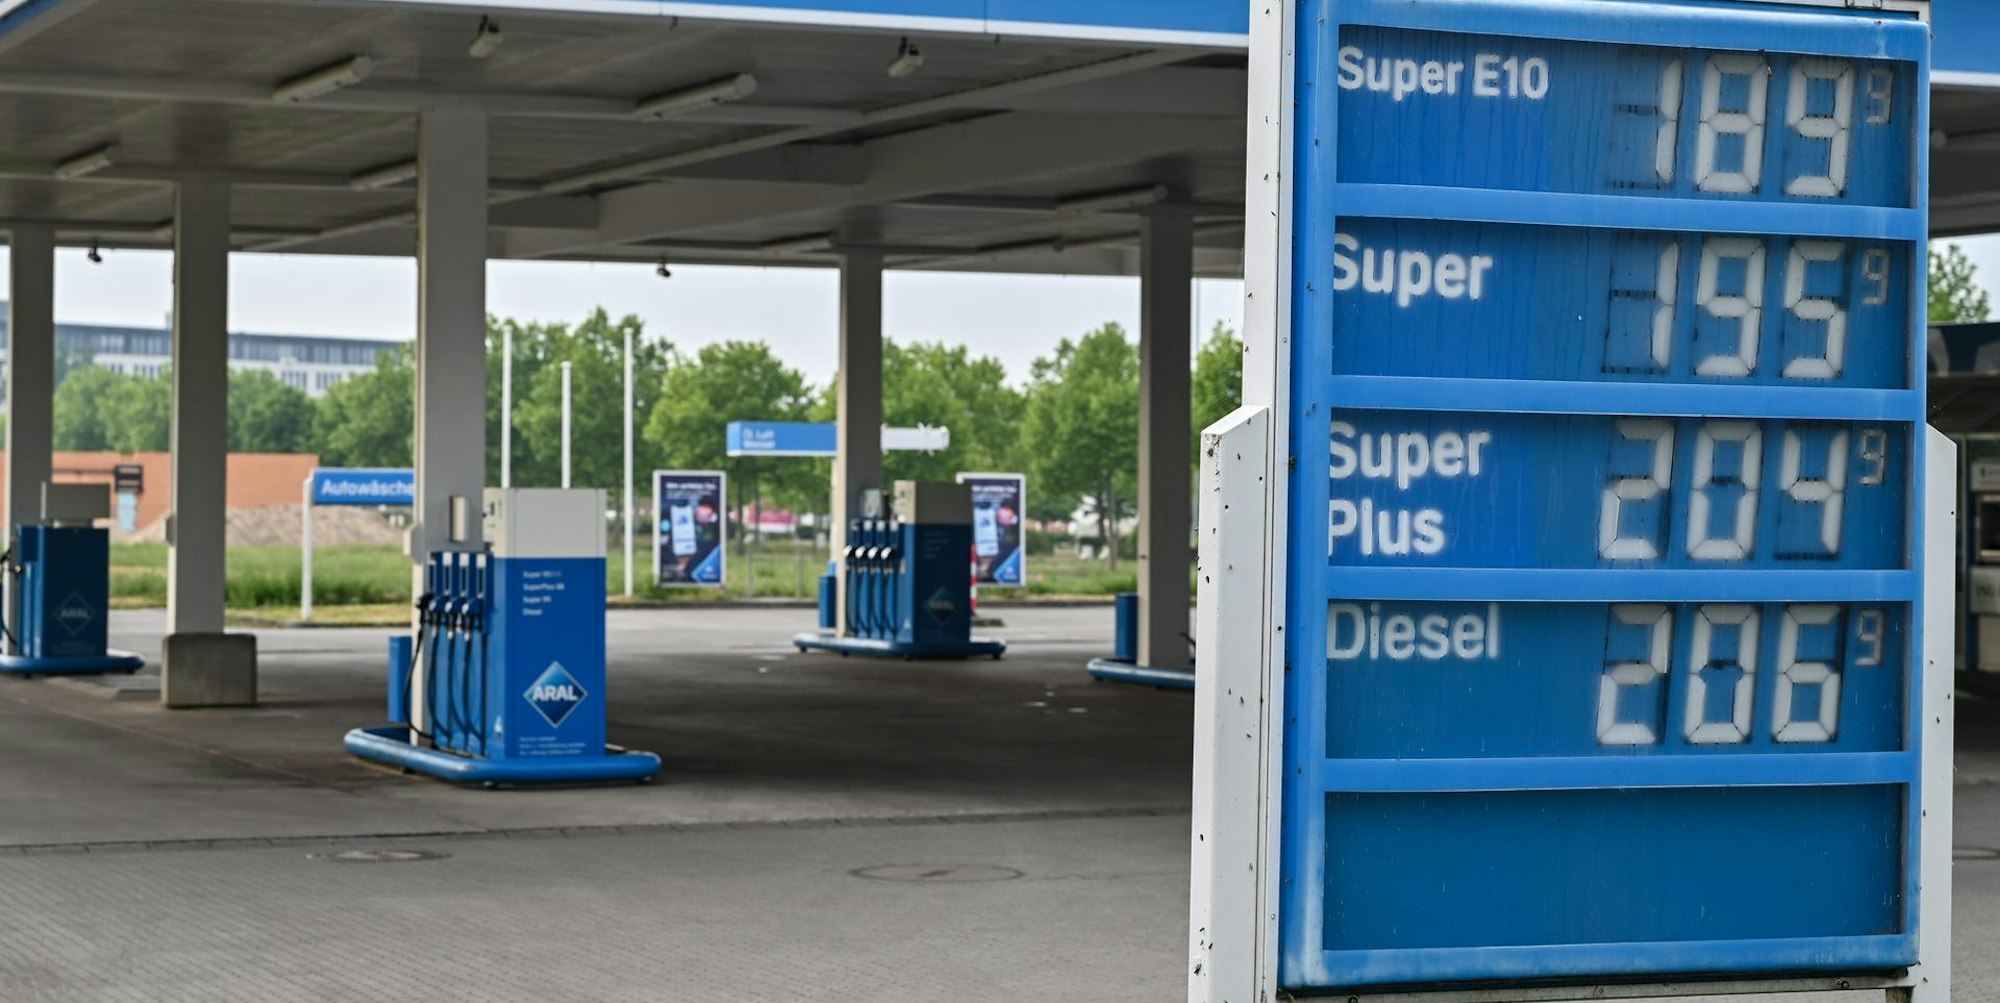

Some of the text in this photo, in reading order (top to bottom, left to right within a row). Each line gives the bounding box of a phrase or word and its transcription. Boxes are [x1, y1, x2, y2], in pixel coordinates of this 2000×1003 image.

[1337, 46, 1550, 101] Super E10
[1655, 52, 1853, 197] 189
[1333, 232, 1493, 308] Super
[1651, 238, 1846, 378] 195
[1329, 421, 1491, 490] Super
[1598, 419, 1850, 560] 204
[1328, 497, 1445, 557] Plus
[1327, 601, 1499, 661] Diesel
[532, 685, 579, 701] ARAL
[1597, 602, 1841, 744] 206
